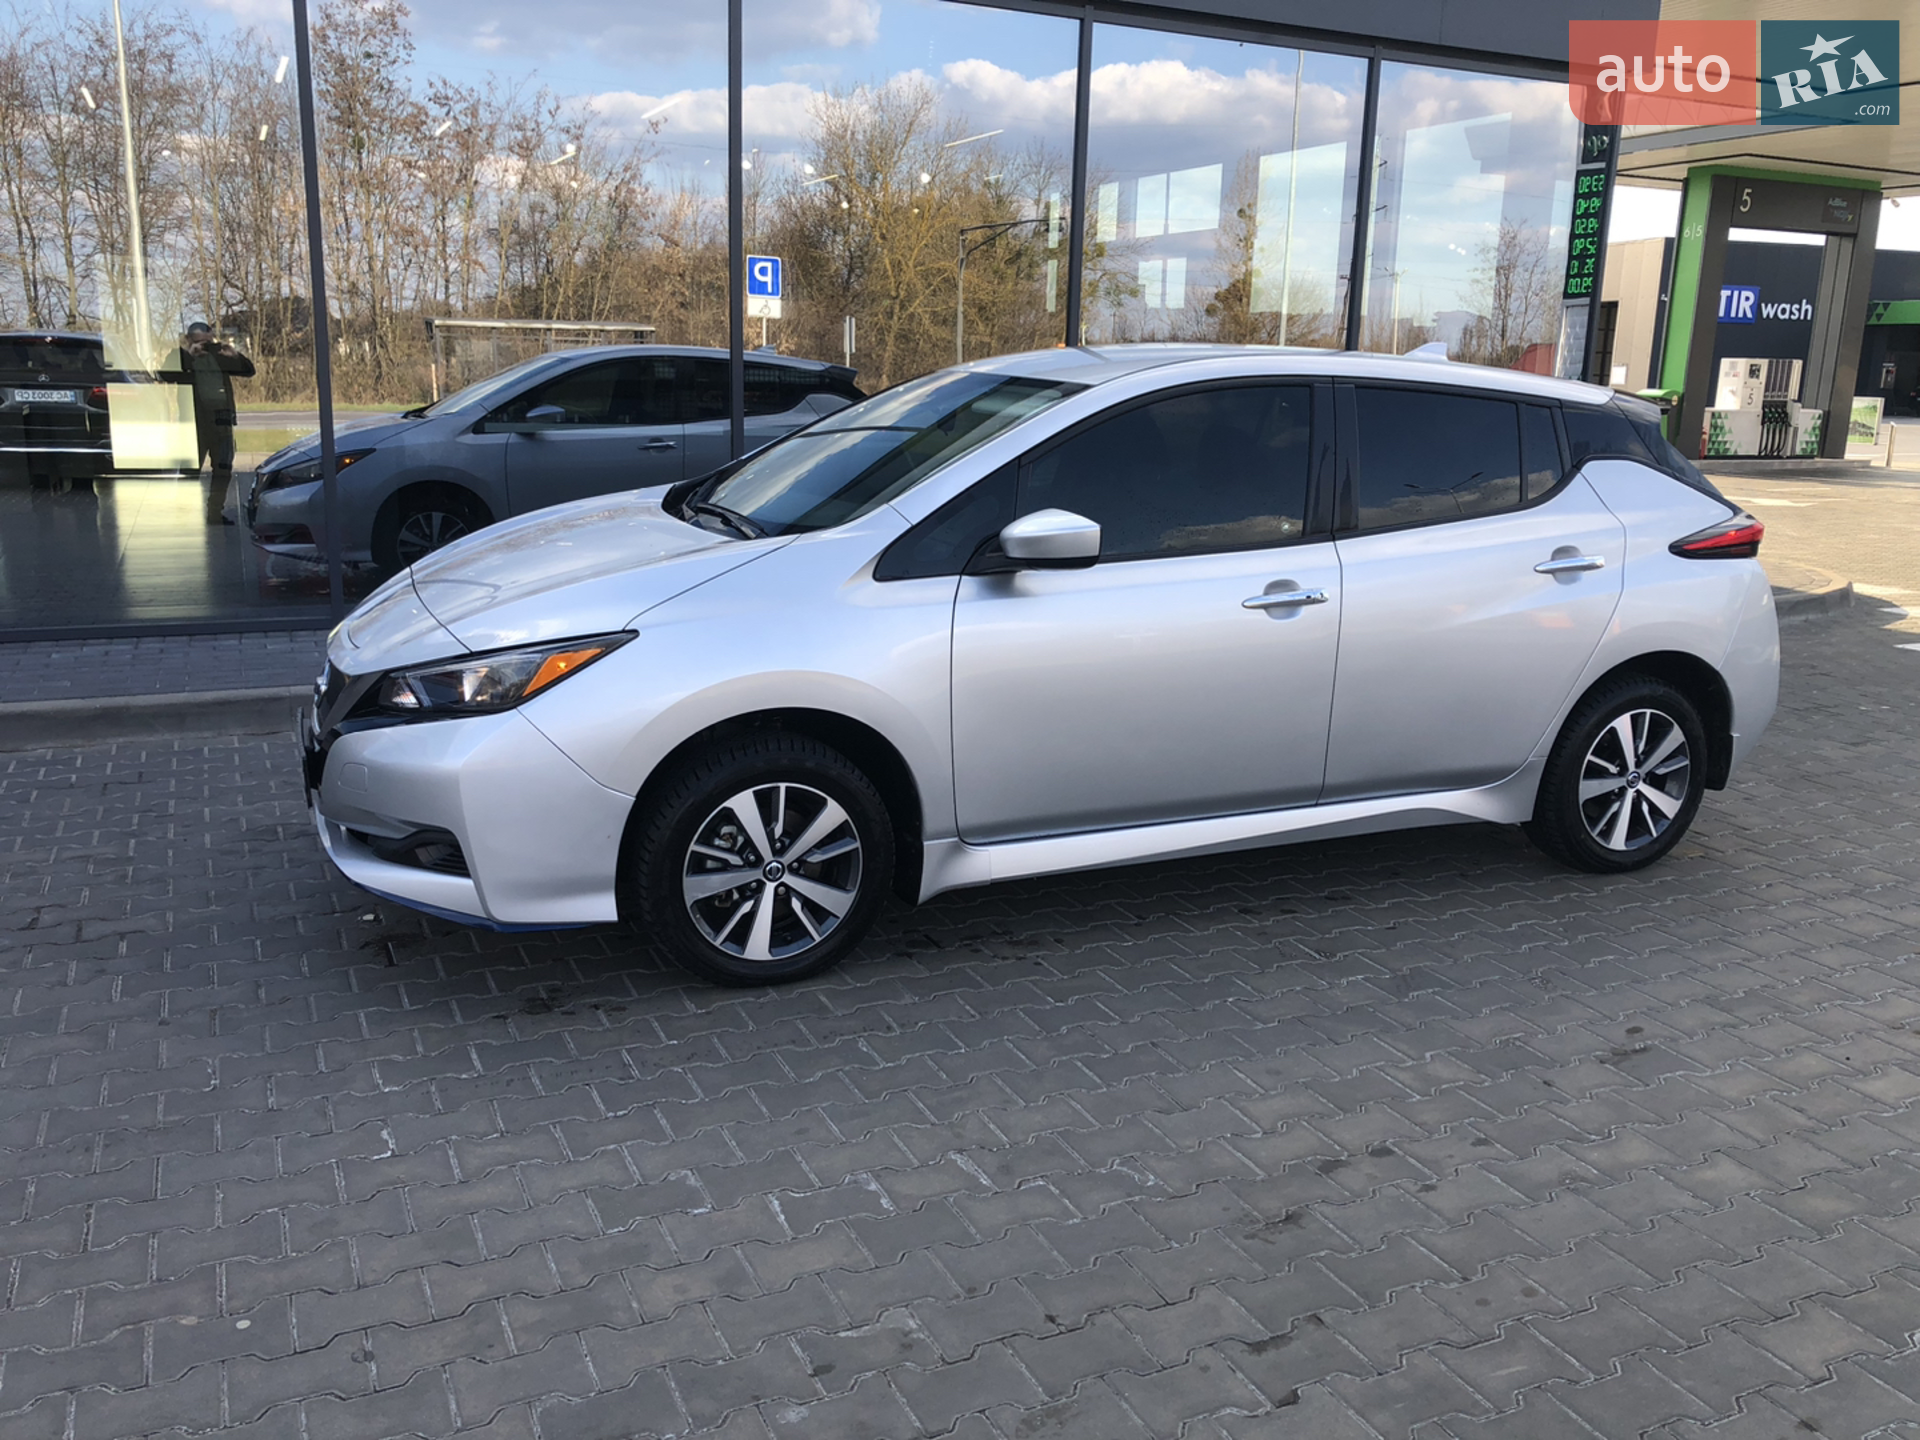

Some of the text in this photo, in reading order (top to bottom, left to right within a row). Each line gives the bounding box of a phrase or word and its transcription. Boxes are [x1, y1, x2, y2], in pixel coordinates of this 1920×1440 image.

[1739, 188, 1752, 213] 5
[1718, 290, 1812, 321] TIR wash
[1747, 393, 1754, 406] 5
